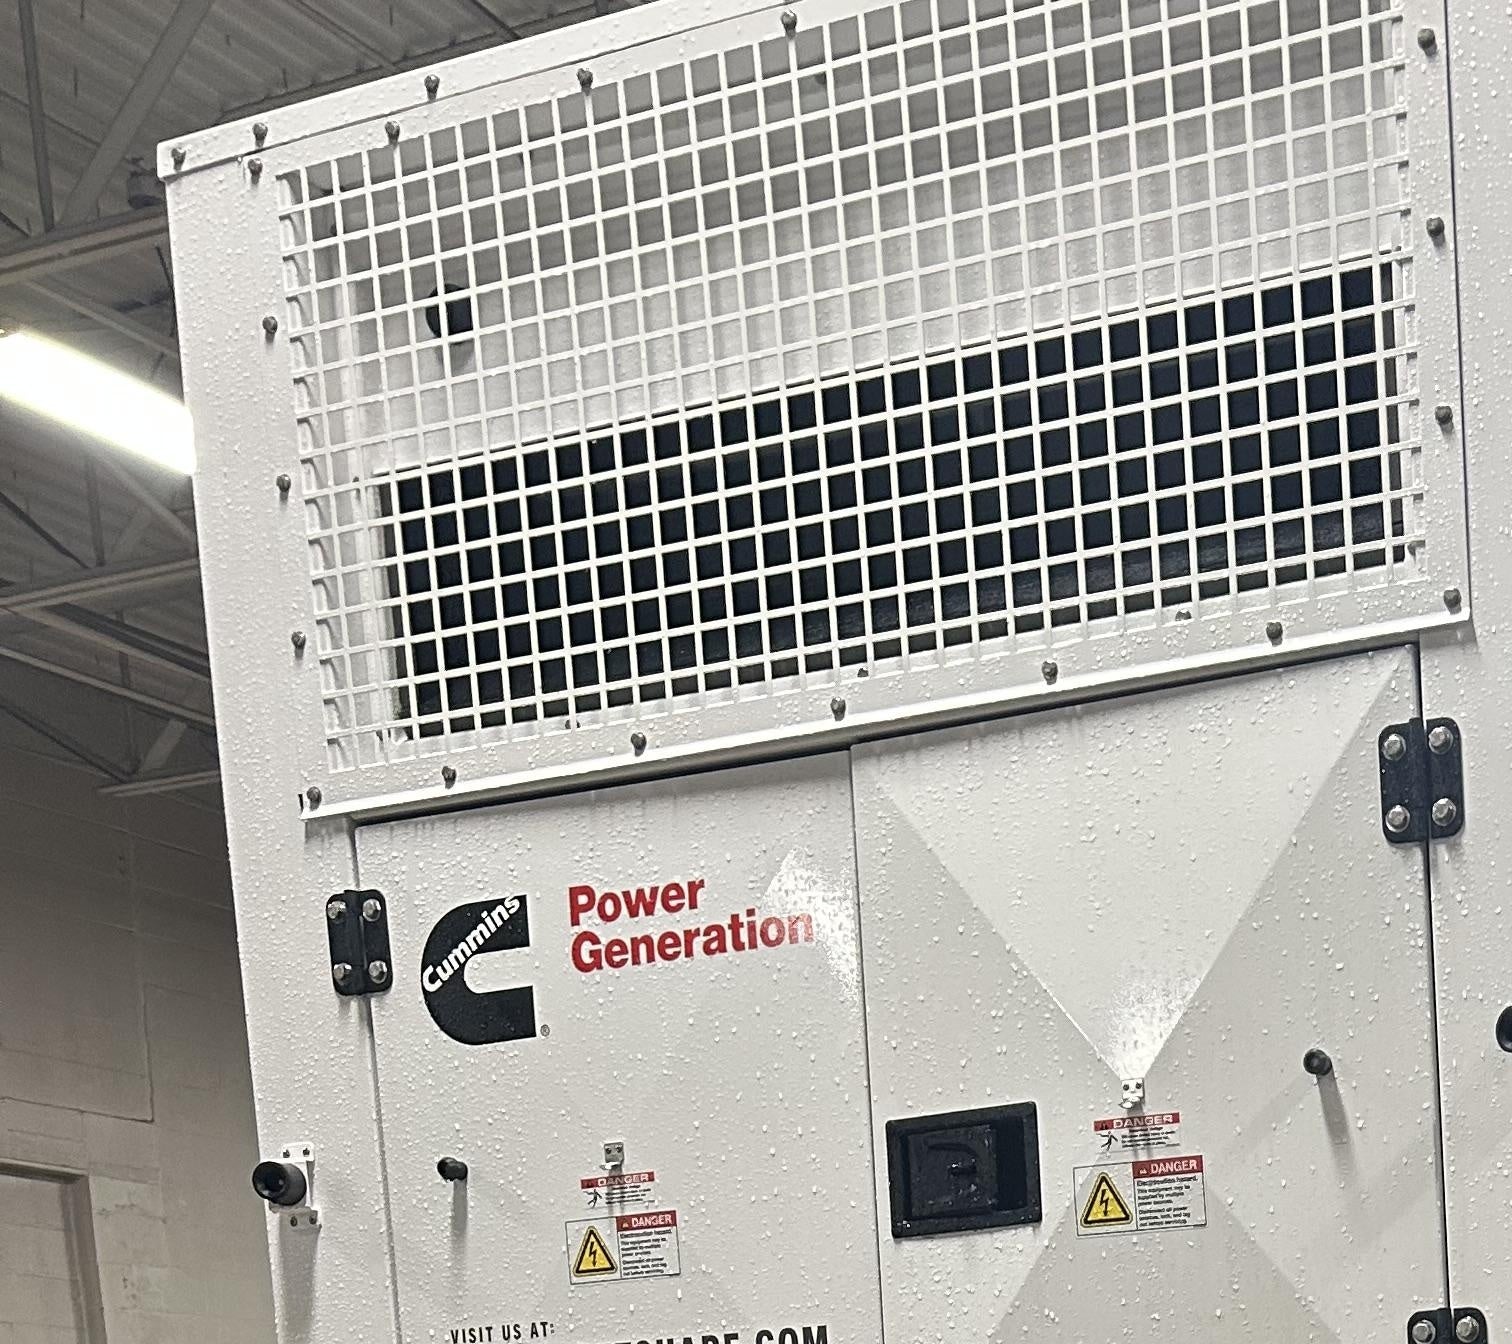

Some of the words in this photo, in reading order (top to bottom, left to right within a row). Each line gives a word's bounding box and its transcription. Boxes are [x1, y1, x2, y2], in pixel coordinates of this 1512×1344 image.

[568, 878, 705, 927] Power
[421, 896, 522, 993] Cummins
[571, 907, 815, 974] Generation
[1113, 1114, 1174, 1129] DANGER
[1150, 1159, 1198, 1174] DANGER
[598, 1172, 649, 1186] DANGER
[631, 1213, 673, 1228] DANGER
[501, 1323, 521, 1340] US
[530, 1321, 555, 1339] AT:
